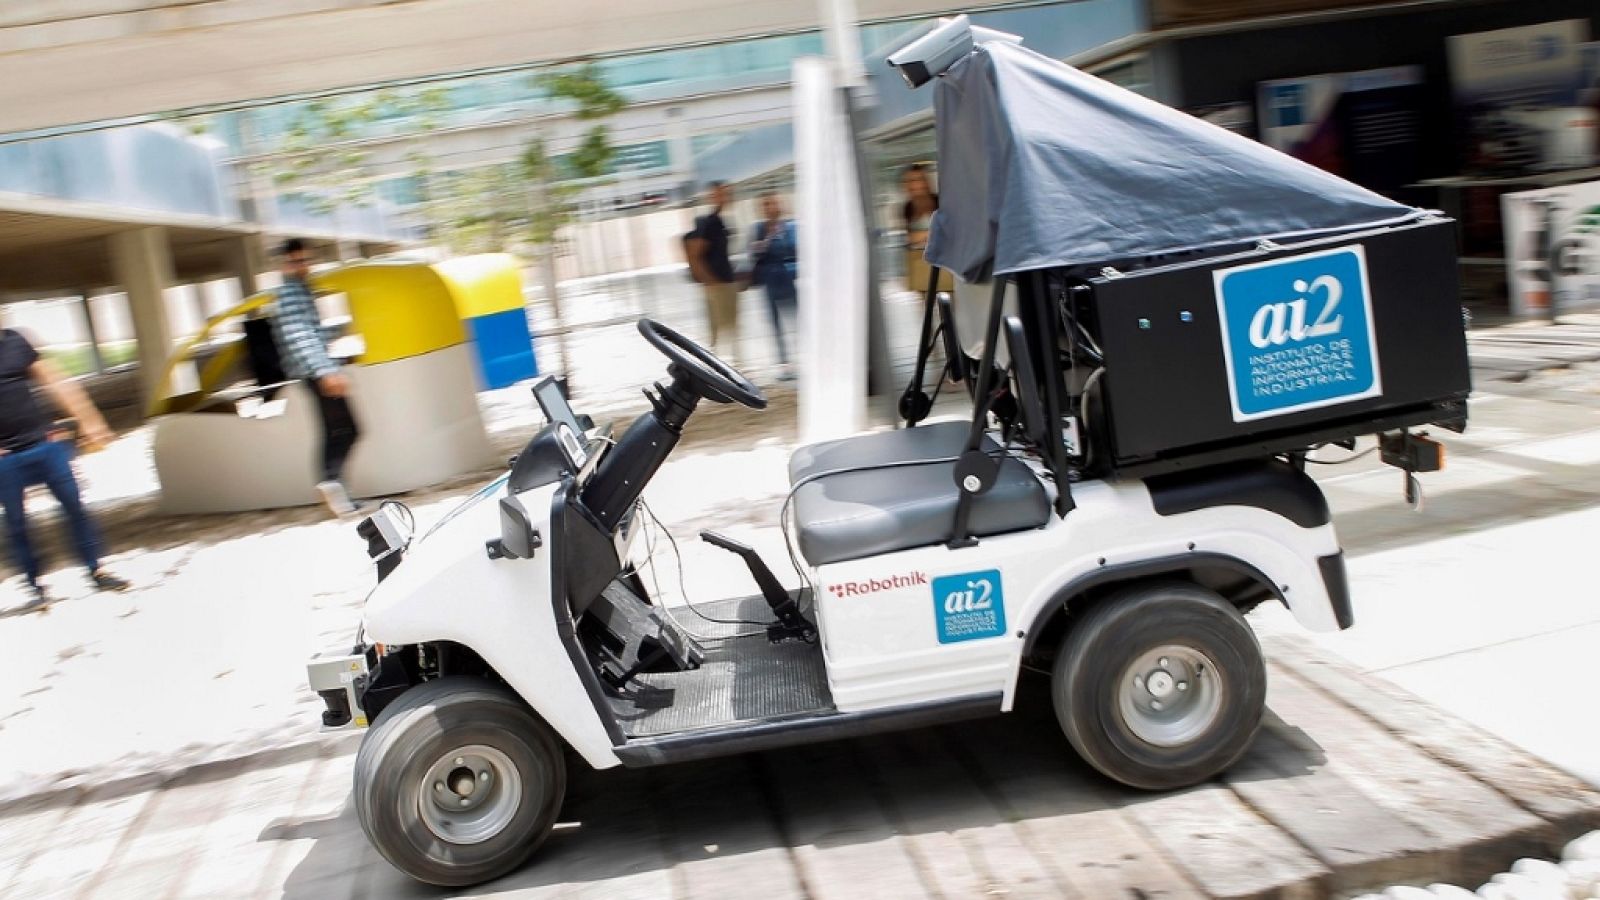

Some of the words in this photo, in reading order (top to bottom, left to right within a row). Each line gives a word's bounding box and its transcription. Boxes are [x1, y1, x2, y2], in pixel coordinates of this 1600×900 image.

[1249, 275, 1343, 348] ai2
[1250, 344, 1325, 365] INSTITUTO
[1329, 339, 1352, 352] DE
[1253, 371, 1356, 396] INDUSTRIAL
[845, 571, 928, 597] Robotnik
[944, 579, 993, 614] ai2
